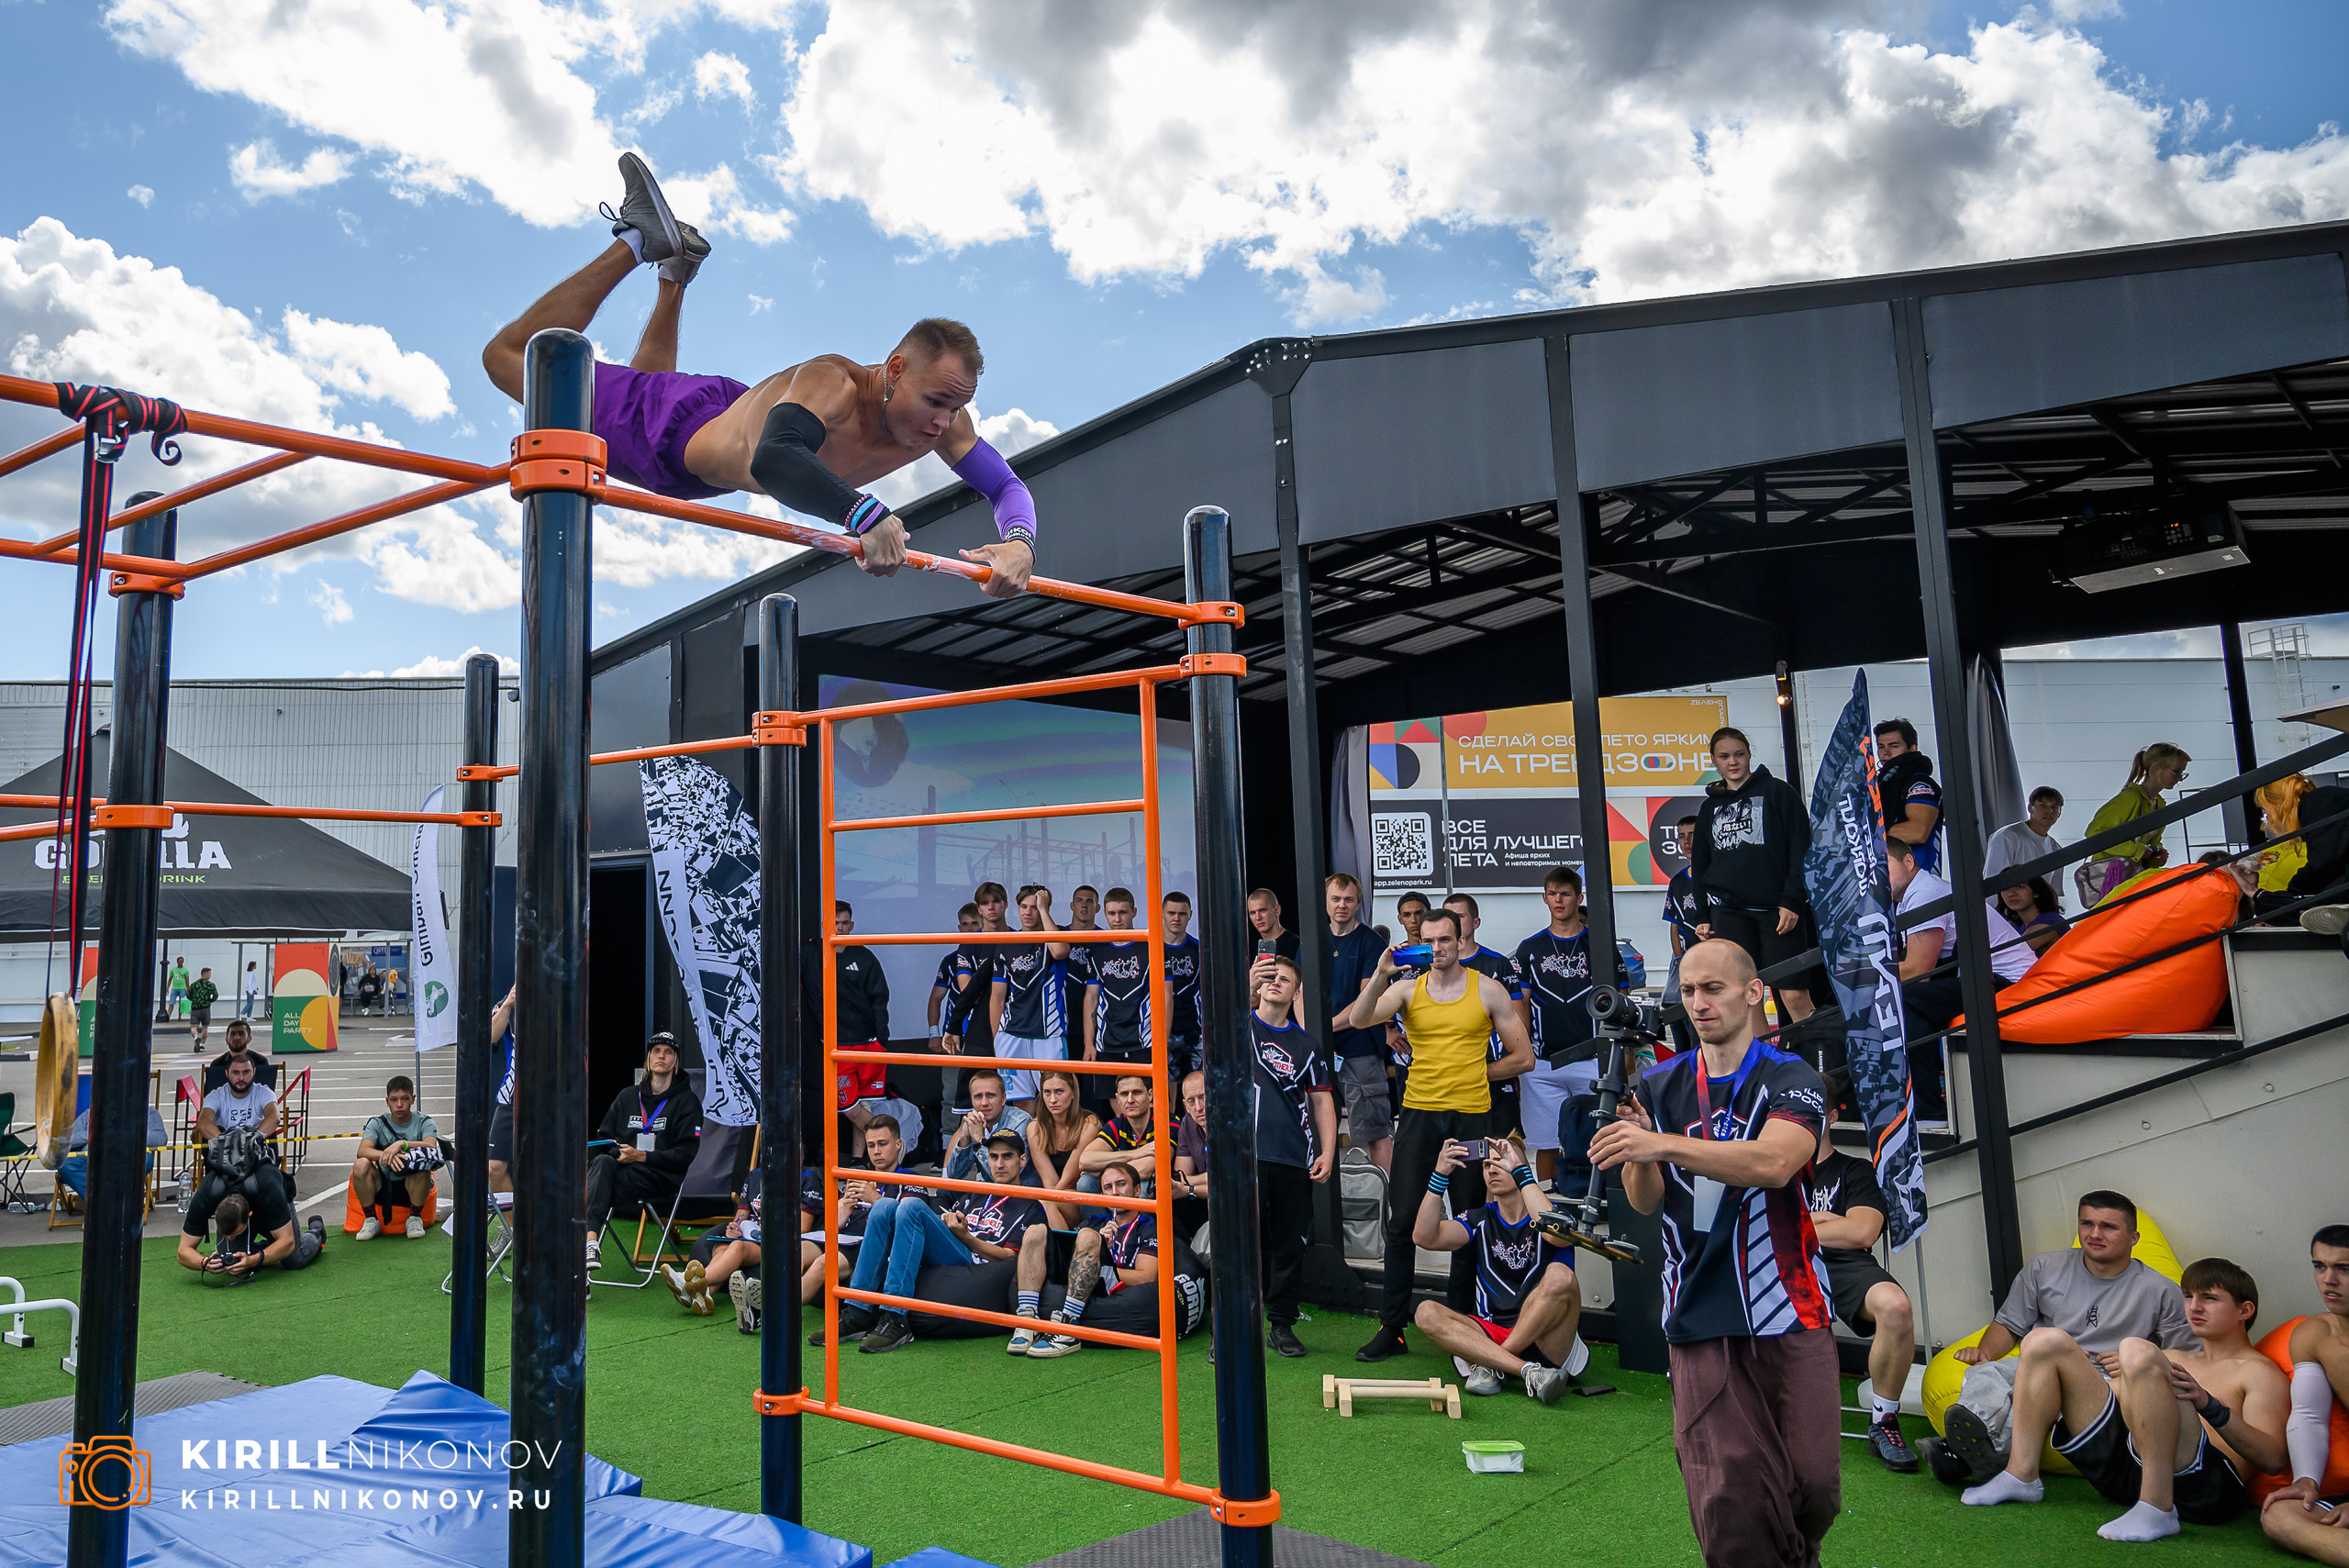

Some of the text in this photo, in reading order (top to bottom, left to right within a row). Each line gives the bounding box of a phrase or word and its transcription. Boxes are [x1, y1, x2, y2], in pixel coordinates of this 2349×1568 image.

[1458, 733, 1536, 749] СДЕЛАЙ
[1542, 735, 1576, 747] СВО
[1459, 754, 1505, 773] НА
[1442, 819, 1486, 834] ВСЕ
[1443, 836, 1487, 851] ДЛЯ
[34, 840, 232, 870] GOLLA
[1504, 851, 1550, 860] Афиша ярких
[1374, 878, 1432, 887] app.zelenopark.ru
[1174, 1273, 1199, 1334] GORILL
